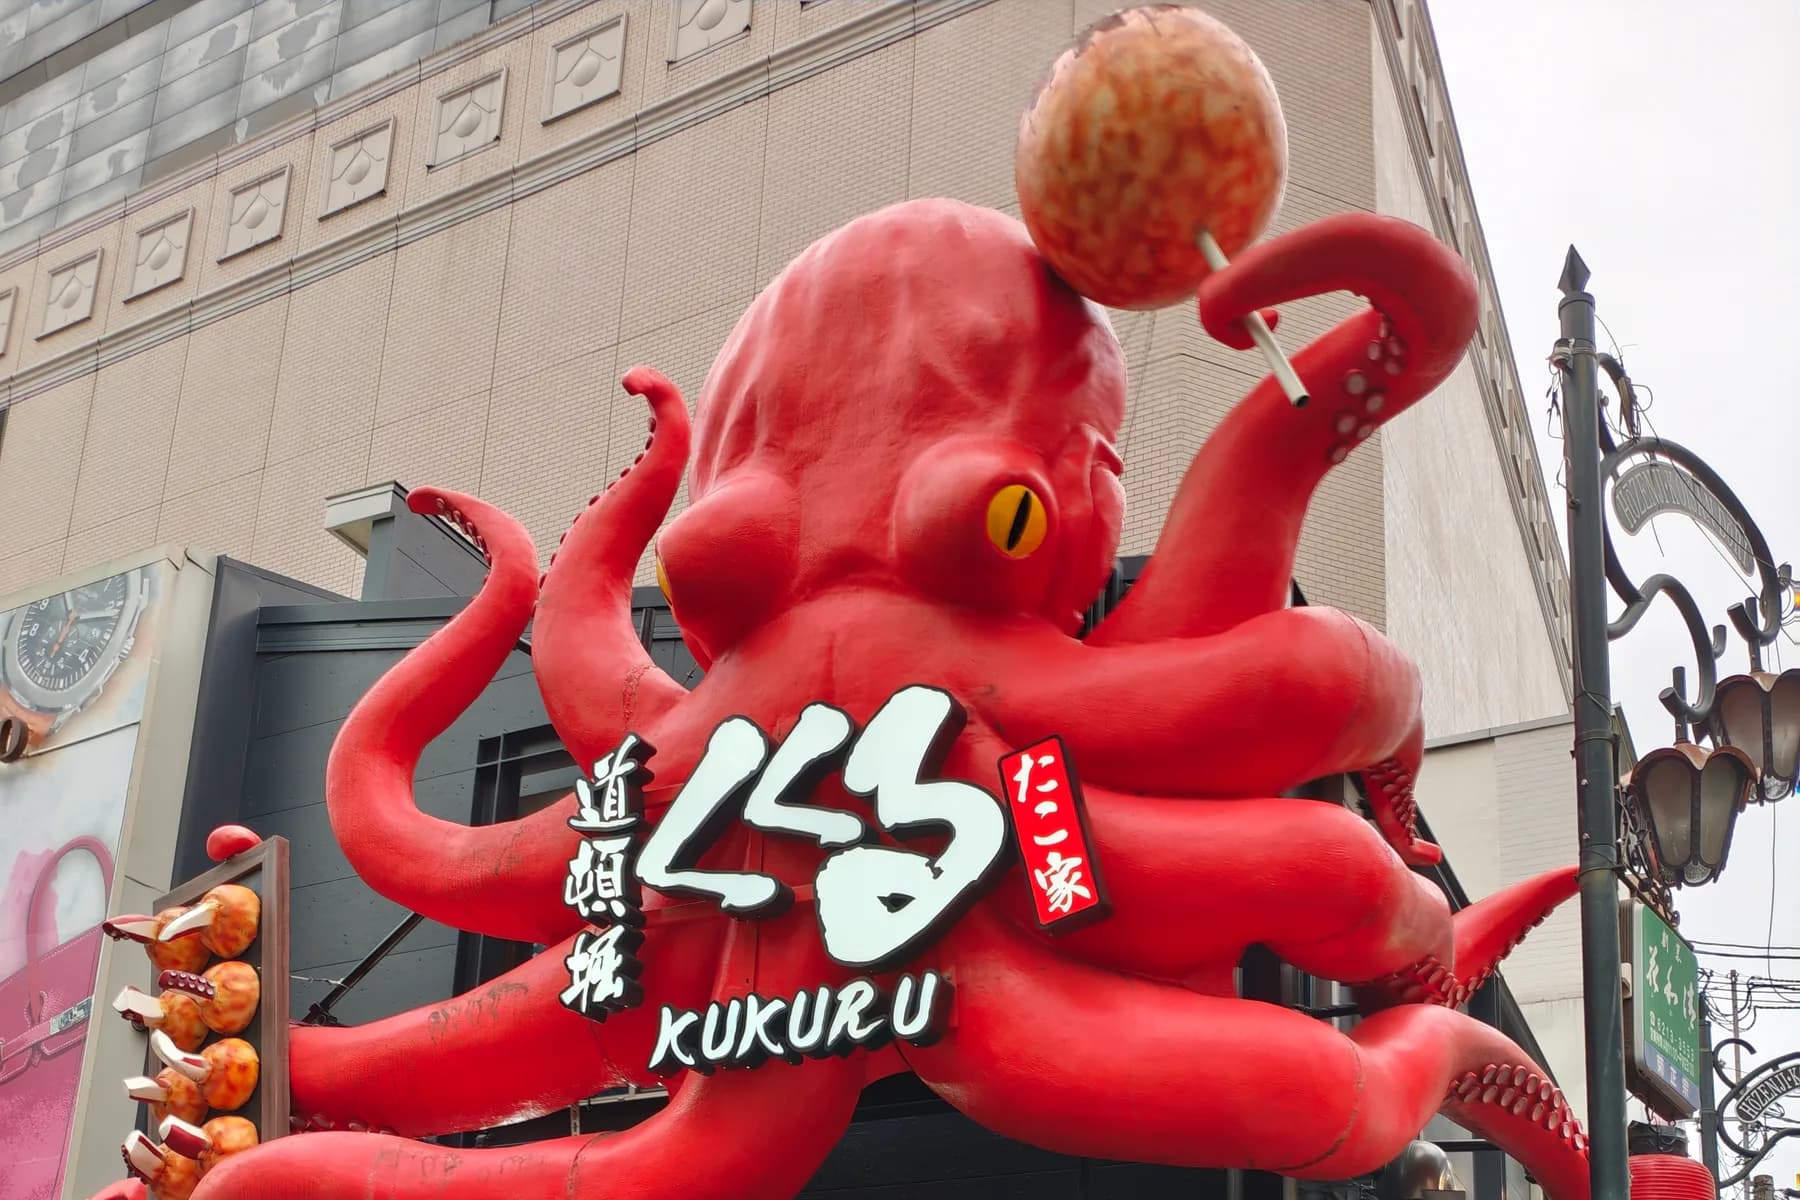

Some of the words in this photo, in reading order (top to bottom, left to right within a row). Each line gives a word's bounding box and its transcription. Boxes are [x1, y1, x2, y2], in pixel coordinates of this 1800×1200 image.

[560, 734, 642, 1014] 道頓堀
[636, 686, 1006, 965] くくる
[1013, 753, 1092, 914] たこ家
[648, 971, 939, 1070] KUKURU
